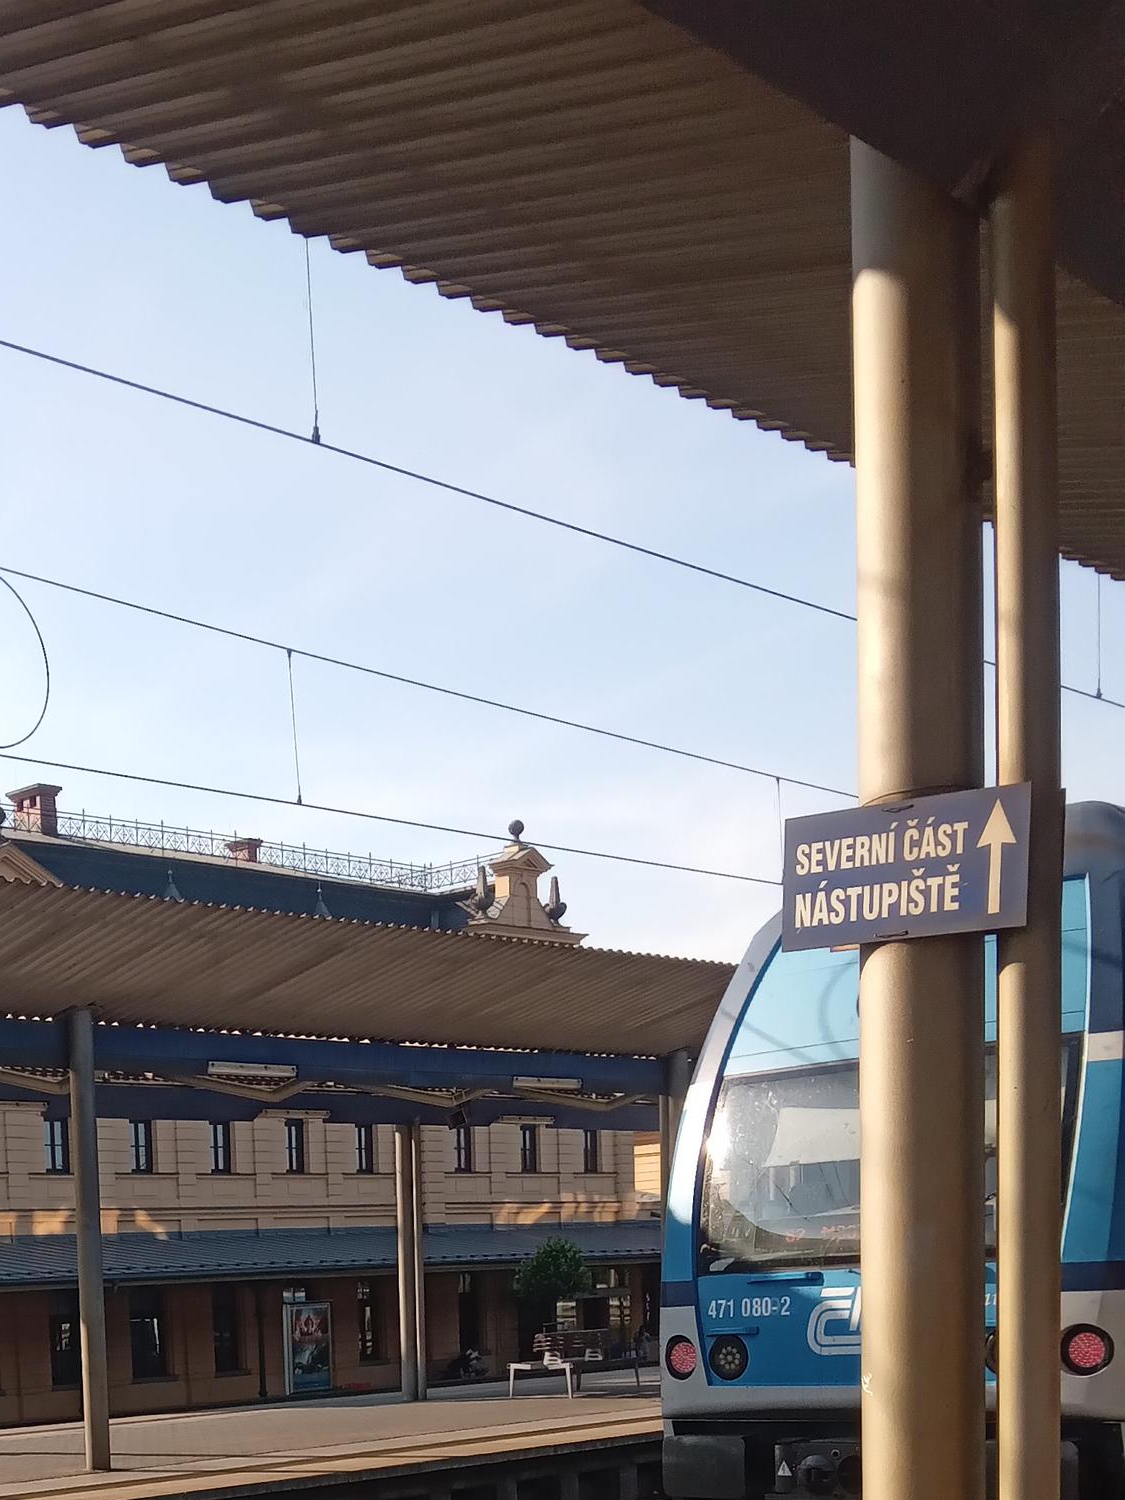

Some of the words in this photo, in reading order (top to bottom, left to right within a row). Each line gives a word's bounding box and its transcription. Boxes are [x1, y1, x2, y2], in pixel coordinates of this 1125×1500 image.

[795, 821, 899, 876] SEVERNÍ
[903, 816, 969, 861] ČÁST
[794, 863, 961, 928] NÁSTUPIŠTĚ
[708, 1299, 735, 1318] 471
[741, 1296, 791, 1317] 080-2
